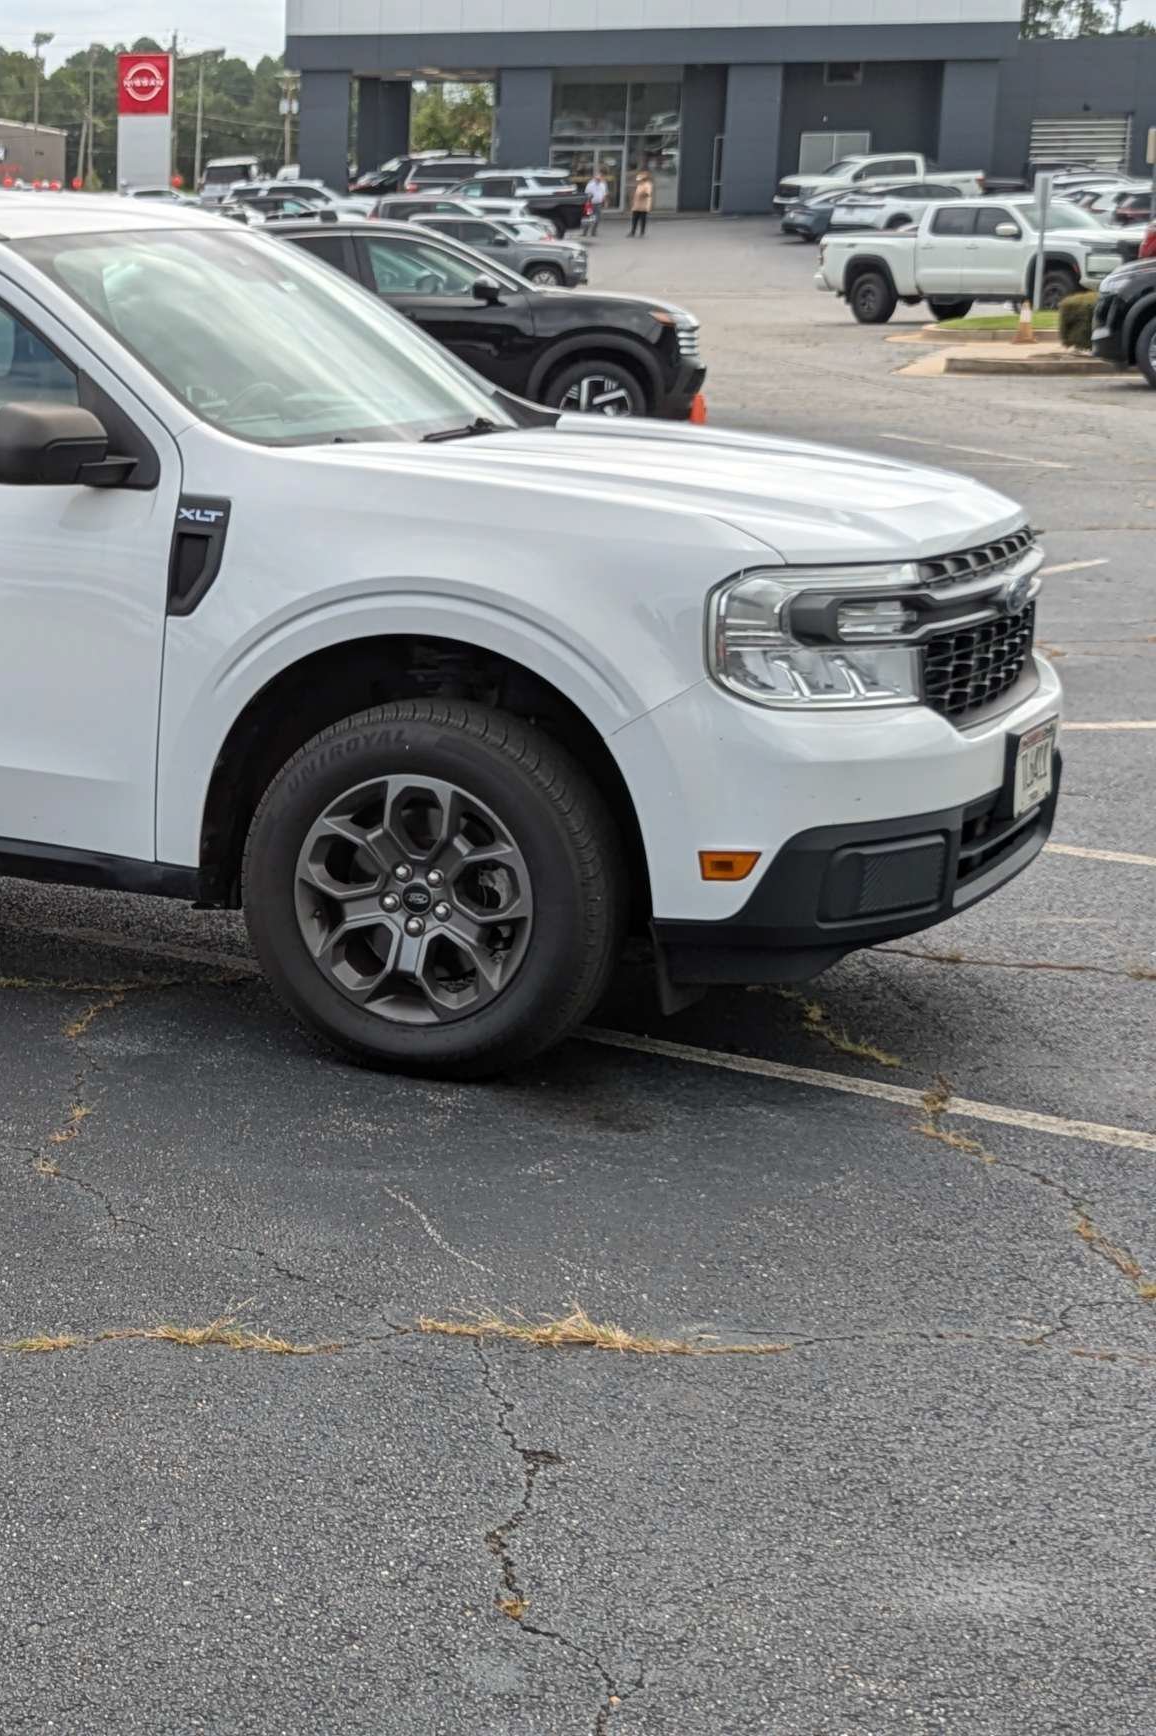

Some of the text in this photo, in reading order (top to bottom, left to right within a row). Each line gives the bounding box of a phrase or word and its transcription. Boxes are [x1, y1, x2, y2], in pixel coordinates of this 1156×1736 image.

[123, 77, 165, 88] NISSAN
[178, 507, 224, 522] XLT
[287, 728, 407, 793] UNIROYAL
